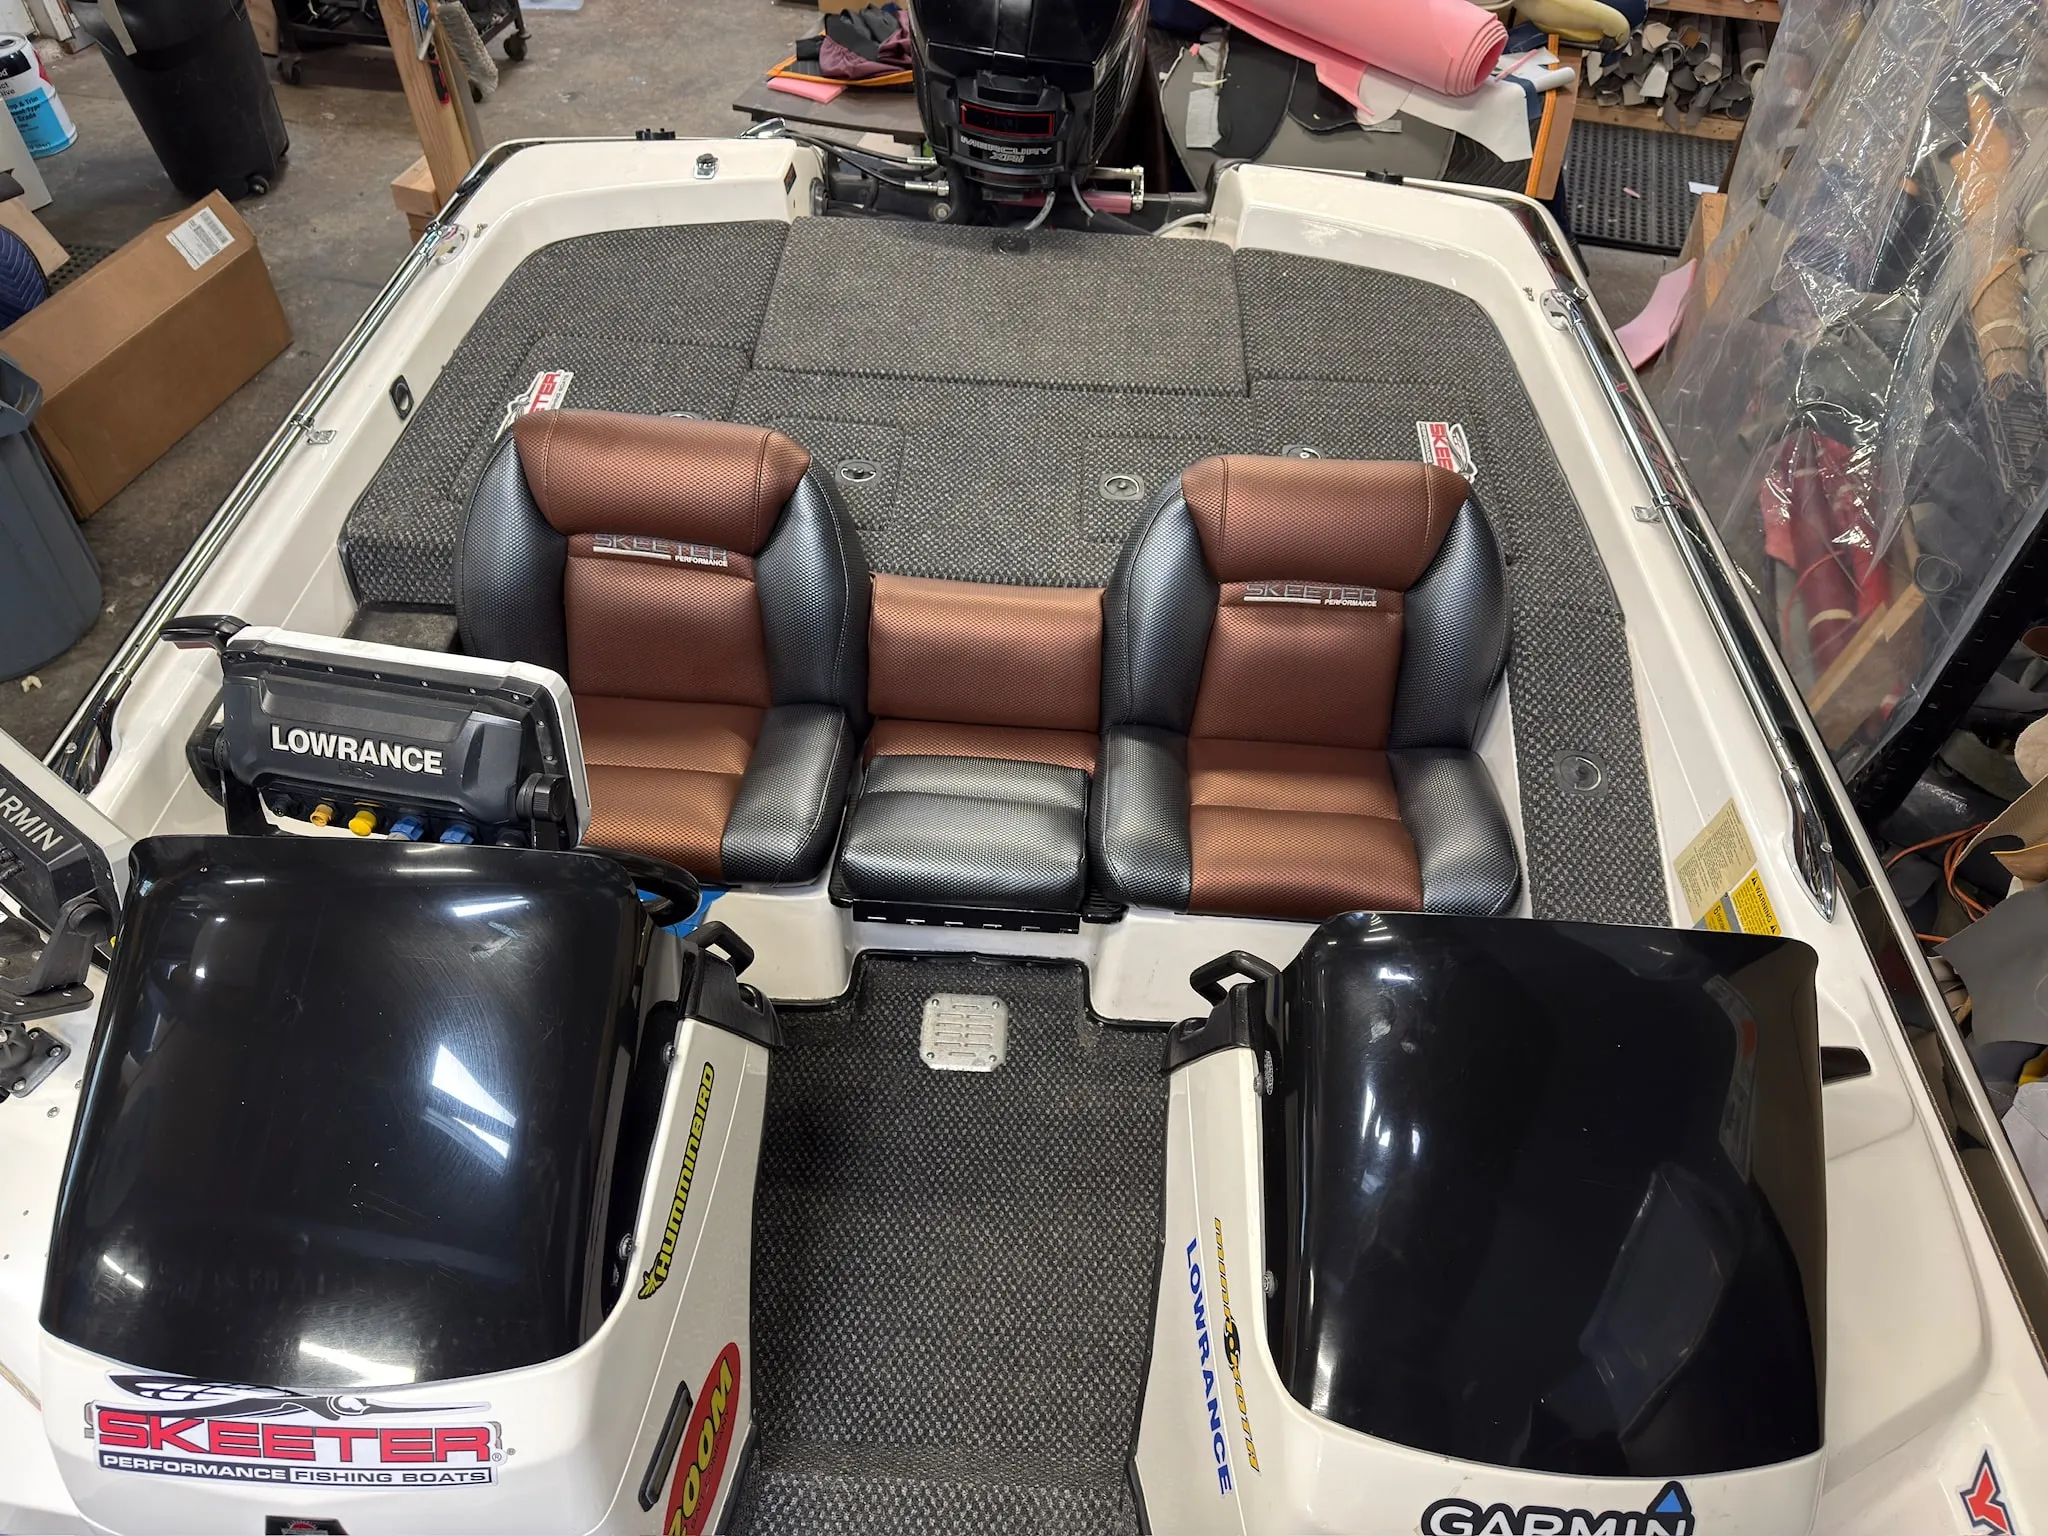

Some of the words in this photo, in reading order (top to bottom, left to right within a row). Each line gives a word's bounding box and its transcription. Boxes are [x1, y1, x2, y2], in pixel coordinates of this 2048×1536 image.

[960, 135, 1052, 155] MERCURY
[529, 373, 560, 414] ETER
[1429, 424, 1454, 472] SKEE
[594, 533, 727, 560] SKEETER
[674, 554, 728, 567] PERFORMANCE
[1245, 583, 1377, 601] SKEETER
[1323, 598, 1377, 607] PERFORMANCE
[271, 724, 444, 775] LOWRANCE
[1754, 886, 1773, 924] WARNING
[654, 1061, 714, 1283] HUMMINBIRD
[1186, 1236, 1232, 1495] LOWRANCE
[98, 1408, 491, 1463] SKEETER
[103, 1454, 287, 1481] PERFORMANCE
[295, 1470, 393, 1483] FISHING
[402, 1471, 486, 1483] BOATS
